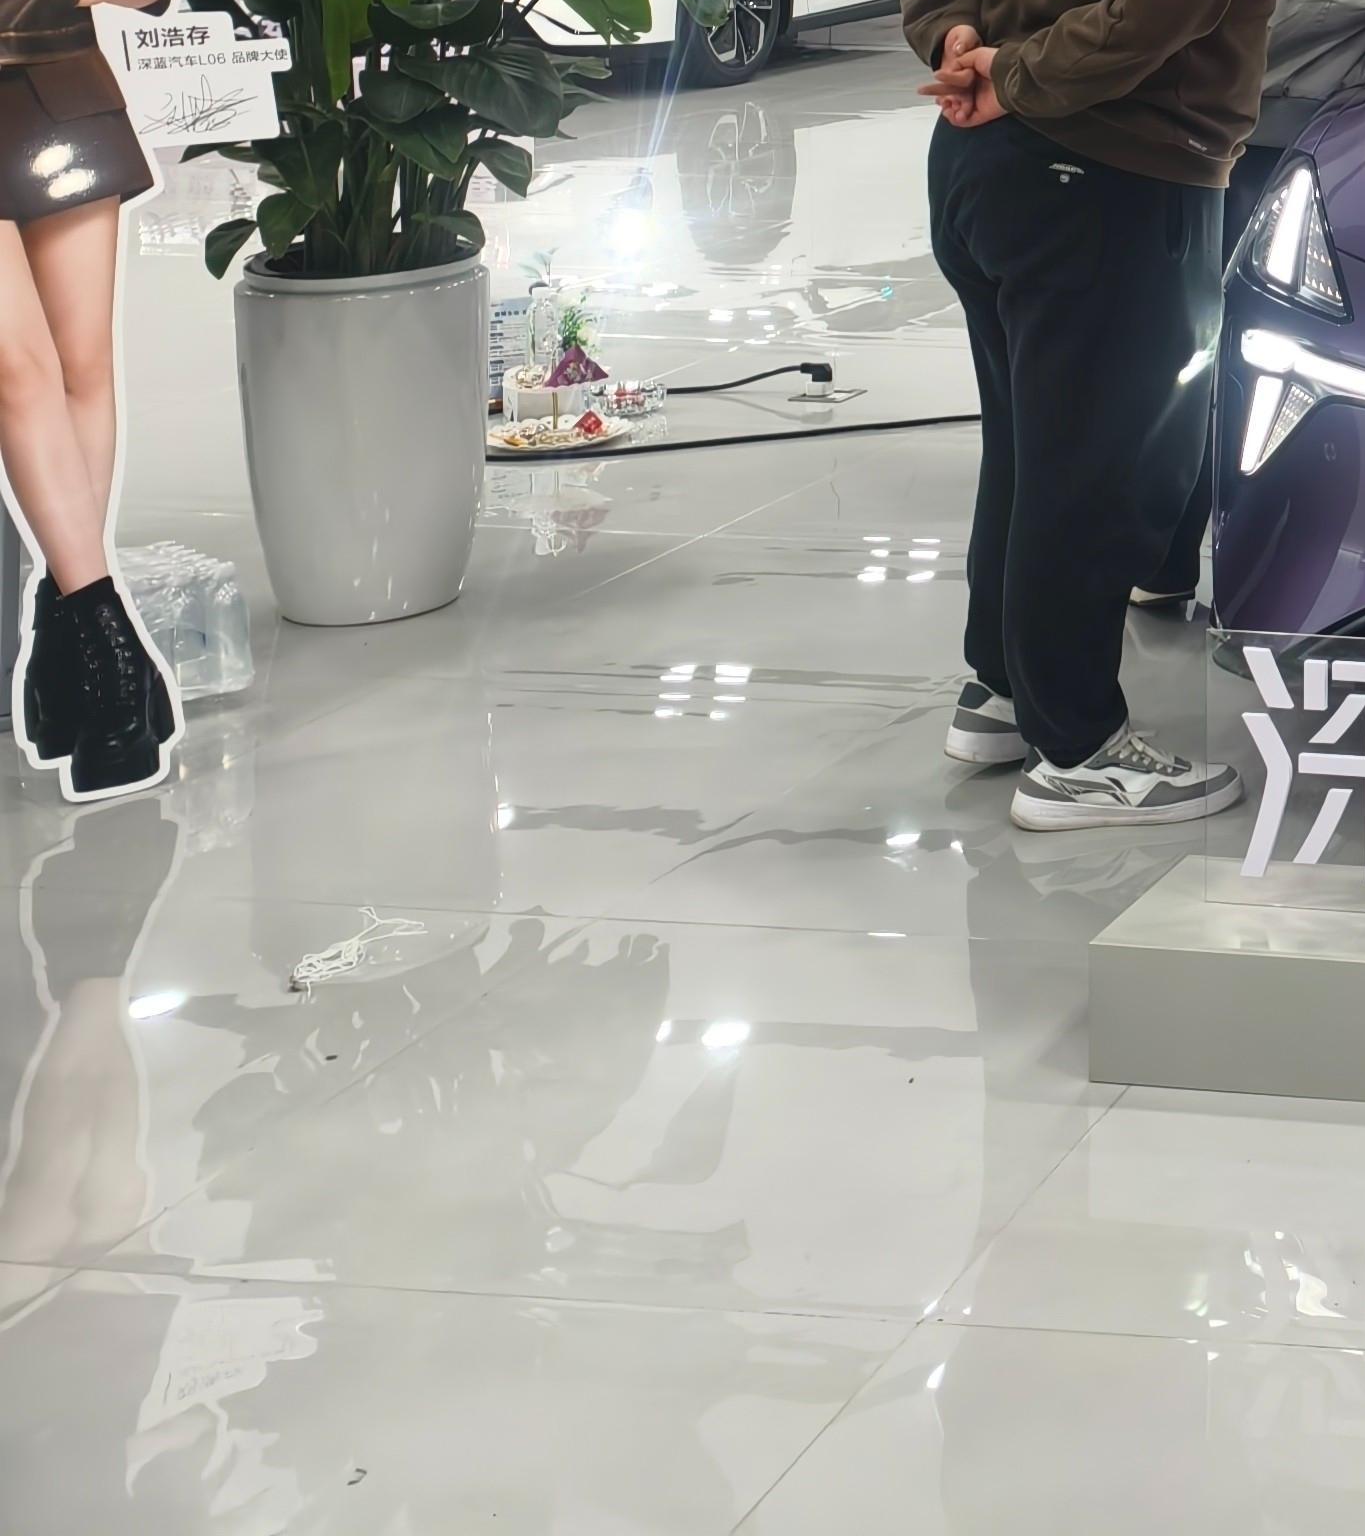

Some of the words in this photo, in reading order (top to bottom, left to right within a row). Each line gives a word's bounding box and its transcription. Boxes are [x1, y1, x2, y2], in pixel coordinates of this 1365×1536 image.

[134, 25, 210, 49] 刘浩存
[137, 53, 227, 70] 深蓝汽车L06
[231, 48, 288, 65] 品牌大使
